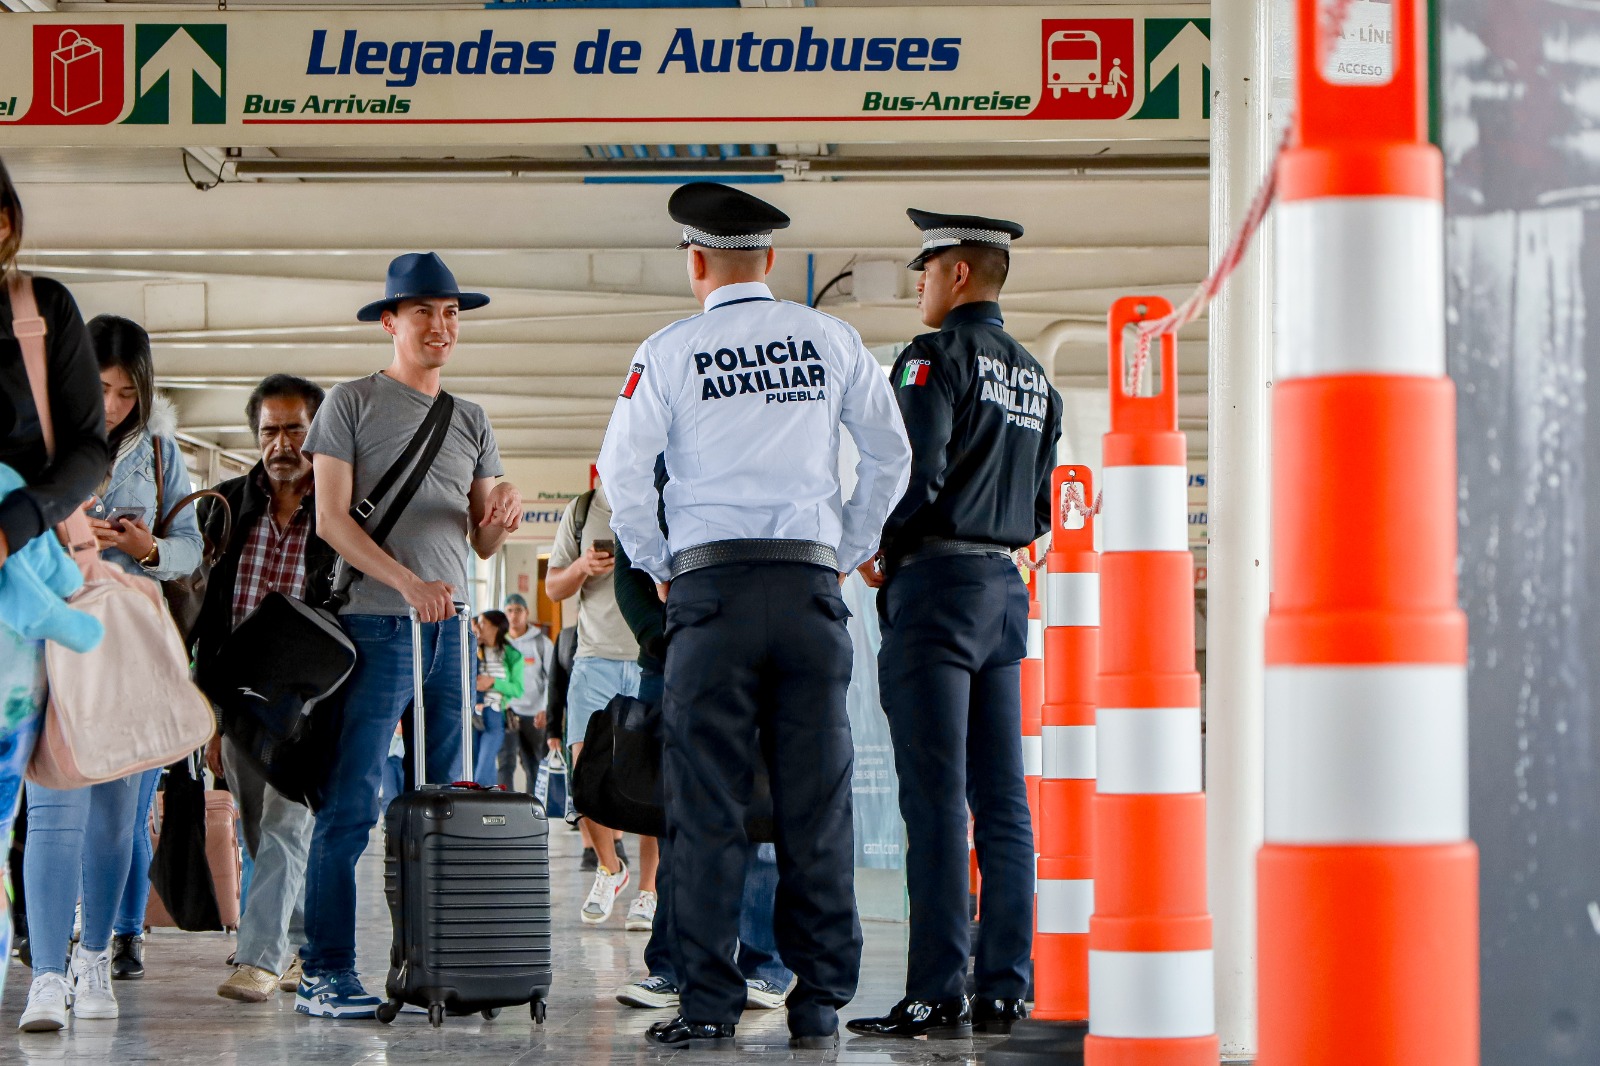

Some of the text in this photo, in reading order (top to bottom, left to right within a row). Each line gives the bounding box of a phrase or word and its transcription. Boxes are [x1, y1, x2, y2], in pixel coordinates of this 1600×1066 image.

[306, 26, 962, 87] Llegadas de Autobuses
[1337, 62, 1383, 76] ACCESO
[243, 94, 411, 115] Bus Arrivals
[861, 91, 1031, 112] Bus-Anreise
[694, 336, 821, 375] POLICÍA
[701, 363, 827, 402] AUXILIAR
[978, 355, 1049, 397] POLICÍA
[765, 389, 827, 405] PUEBLA
